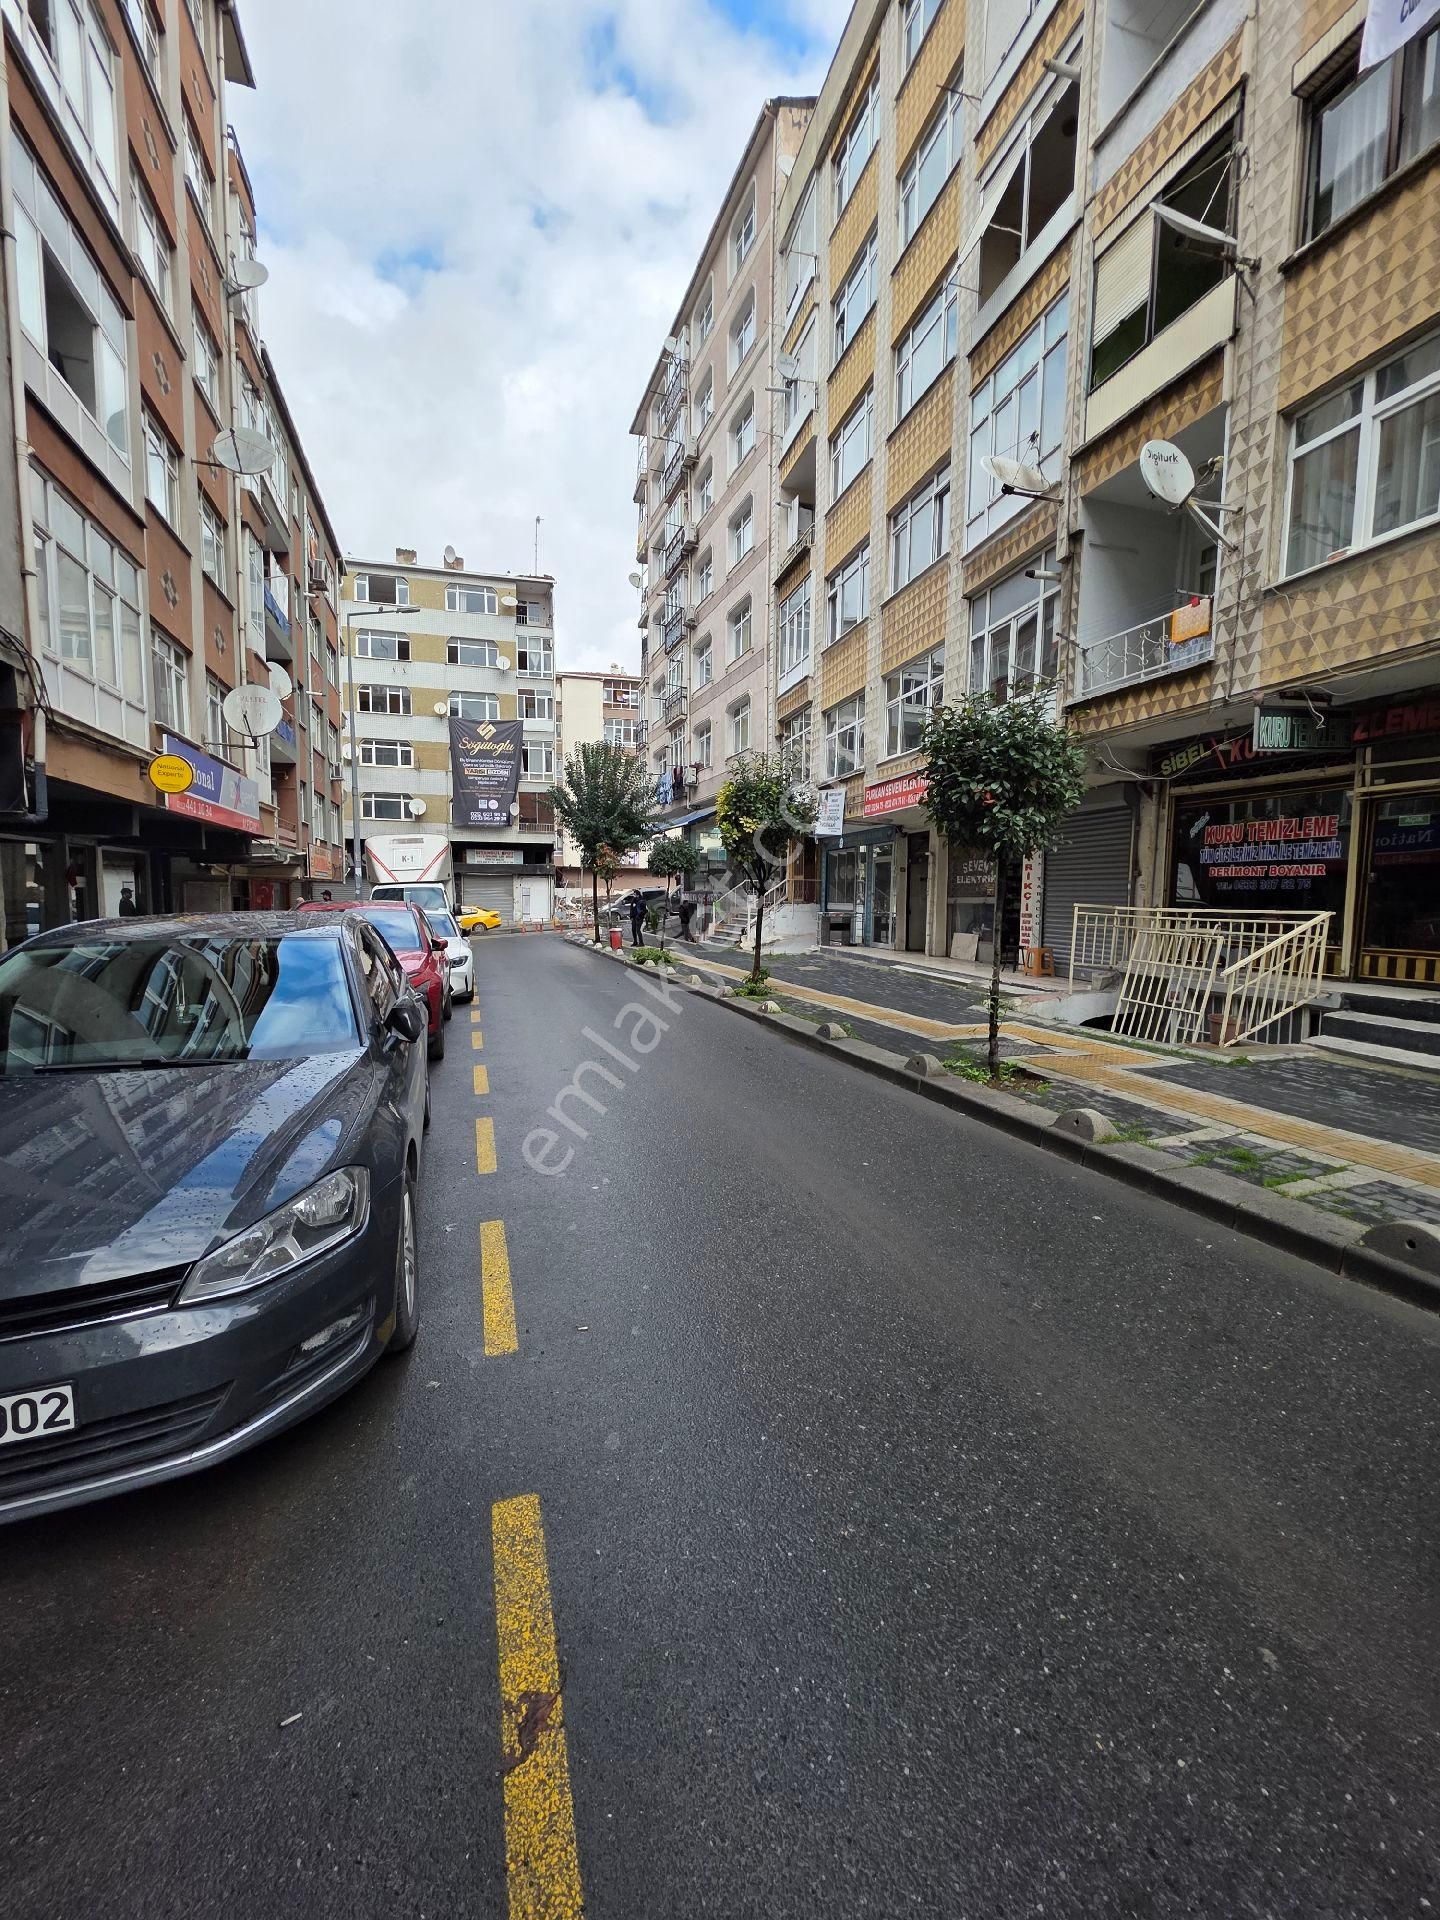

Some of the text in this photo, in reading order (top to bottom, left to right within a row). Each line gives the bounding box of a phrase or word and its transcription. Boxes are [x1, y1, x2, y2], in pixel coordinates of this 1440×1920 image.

[1260, 716, 1292, 748] KURU
[1160, 743, 1211, 776] SİBEL
[866, 785, 886, 801] FURKAN
[886, 780, 902, 796] SEVEN
[186, 799, 196, 814] 441
[205, 804, 212, 817] 34
[1204, 823, 1244, 844] KURU
[1248, 814, 1340, 842] TEMİZLEME
[1200, 846, 1214, 864] TÜM
[1258, 841, 1278, 861] İTİNA
[1279, 840, 1293, 861] İLE
[1293, 838, 1342, 860] TEMİZLENİR
[963, 859, 989, 873] SEVEN
[1208, 864, 1326, 878] DERİMONT BOYANIR
[0, 1392, 70, 1438] 02
